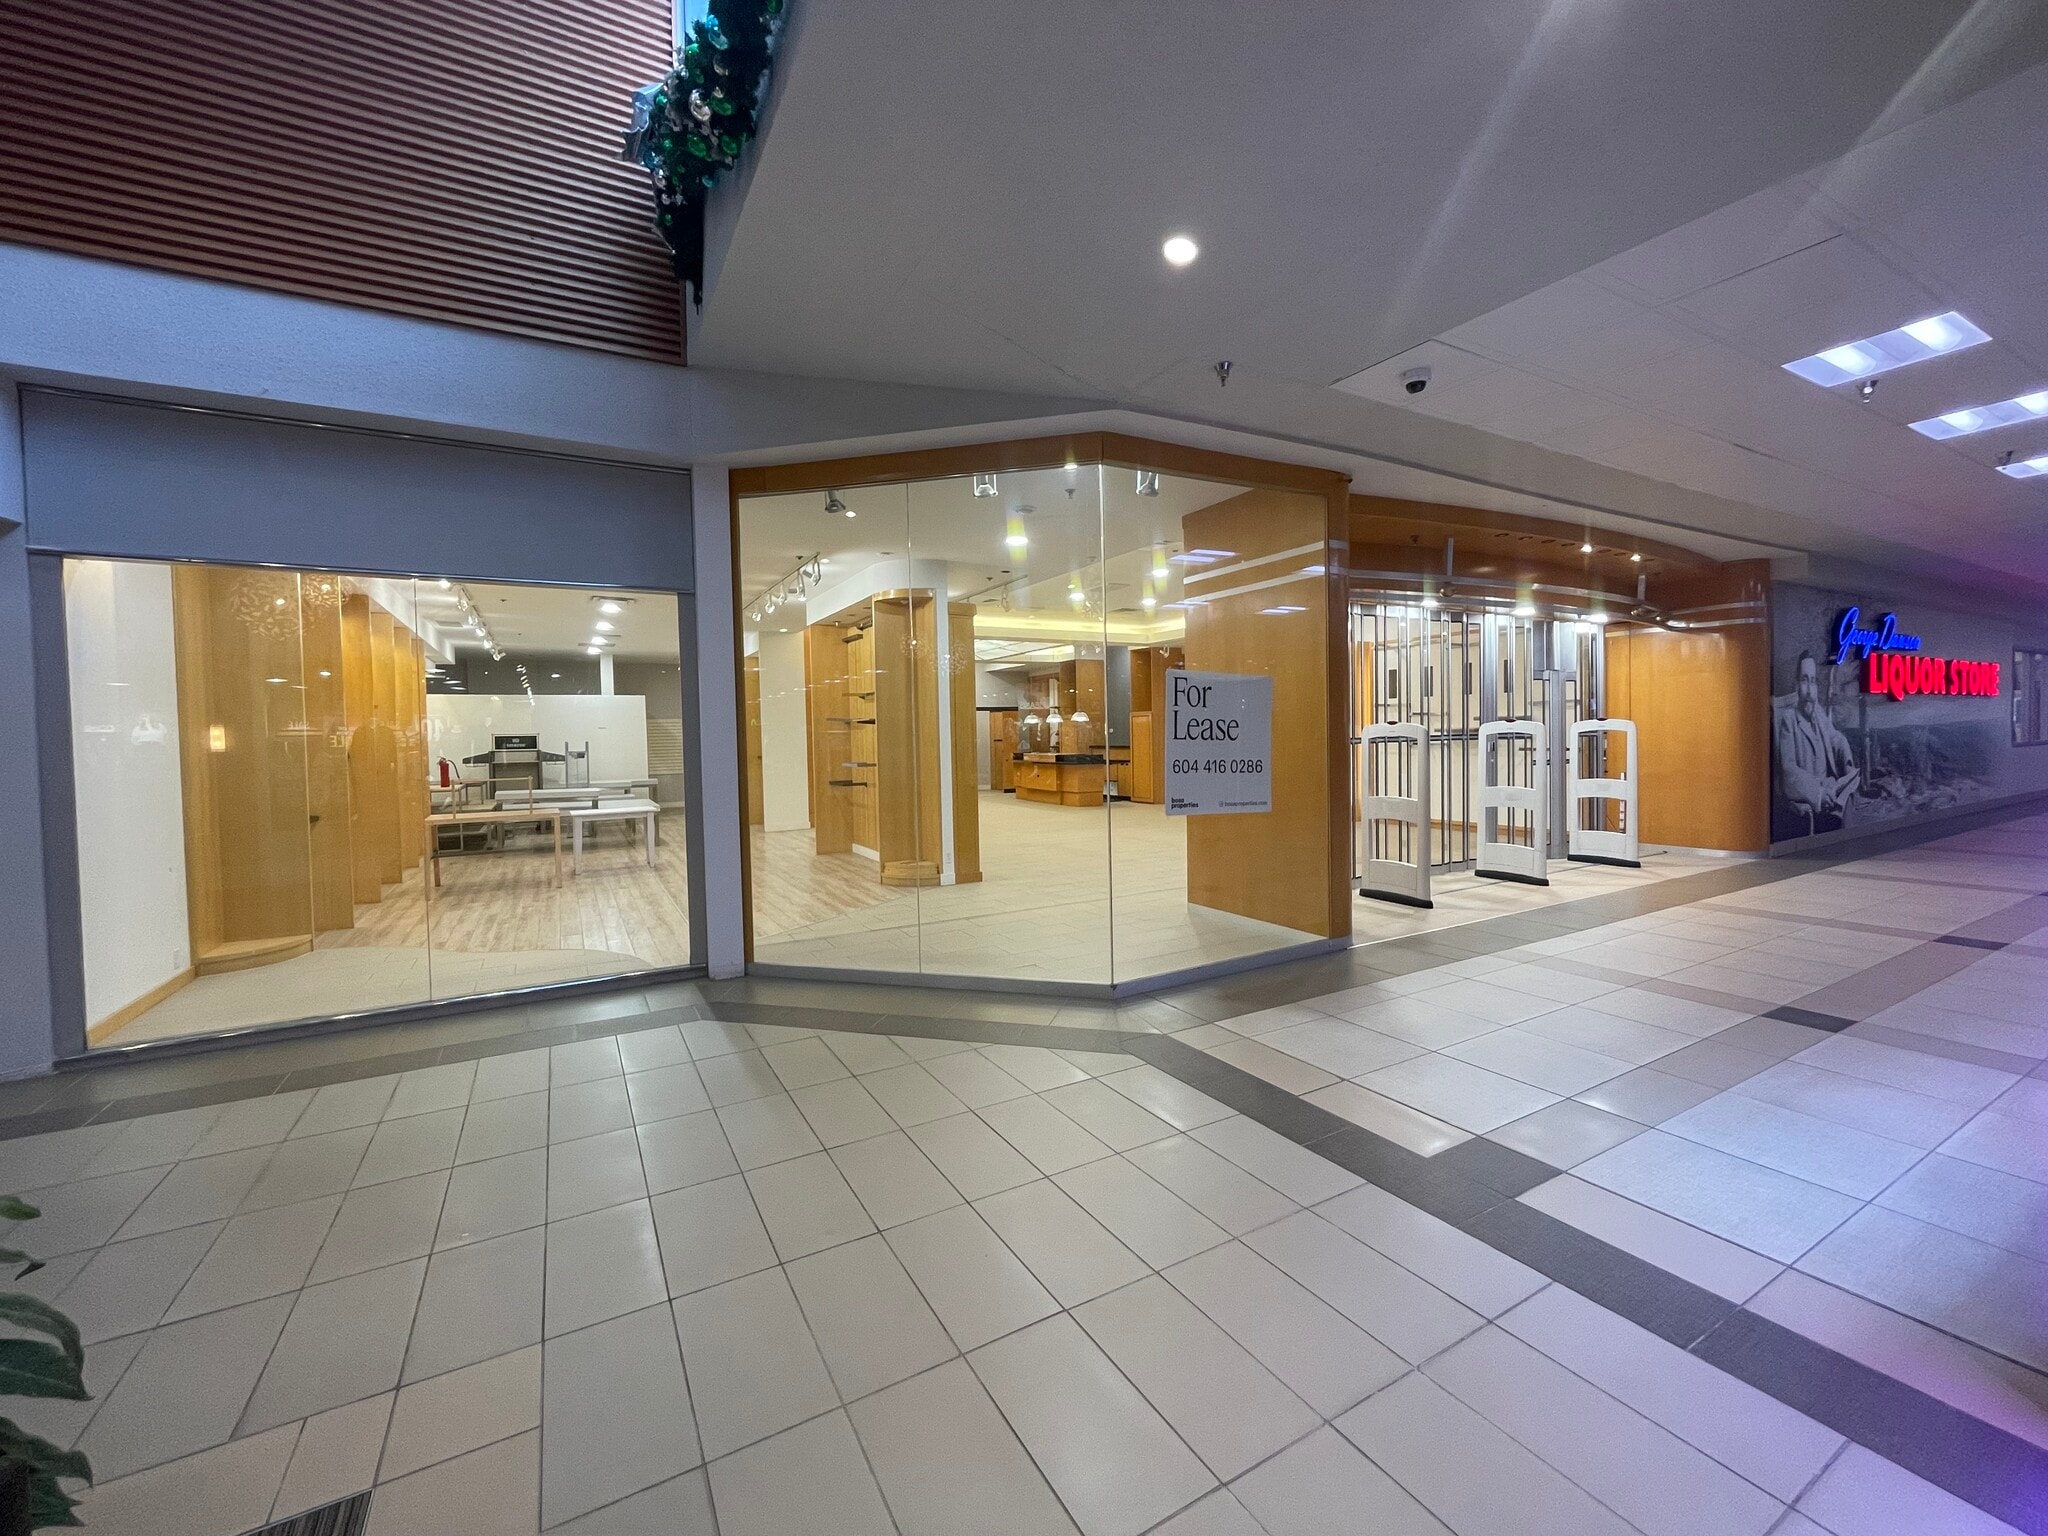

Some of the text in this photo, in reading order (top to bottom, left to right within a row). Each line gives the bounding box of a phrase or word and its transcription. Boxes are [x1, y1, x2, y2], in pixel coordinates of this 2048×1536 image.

[1173, 676, 1212, 708] For
[1869, 653, 2000, 701] LIQUOR STORE
[1172, 710, 1240, 741] Lease
[1172, 759, 1263, 774] 604 416 0286
